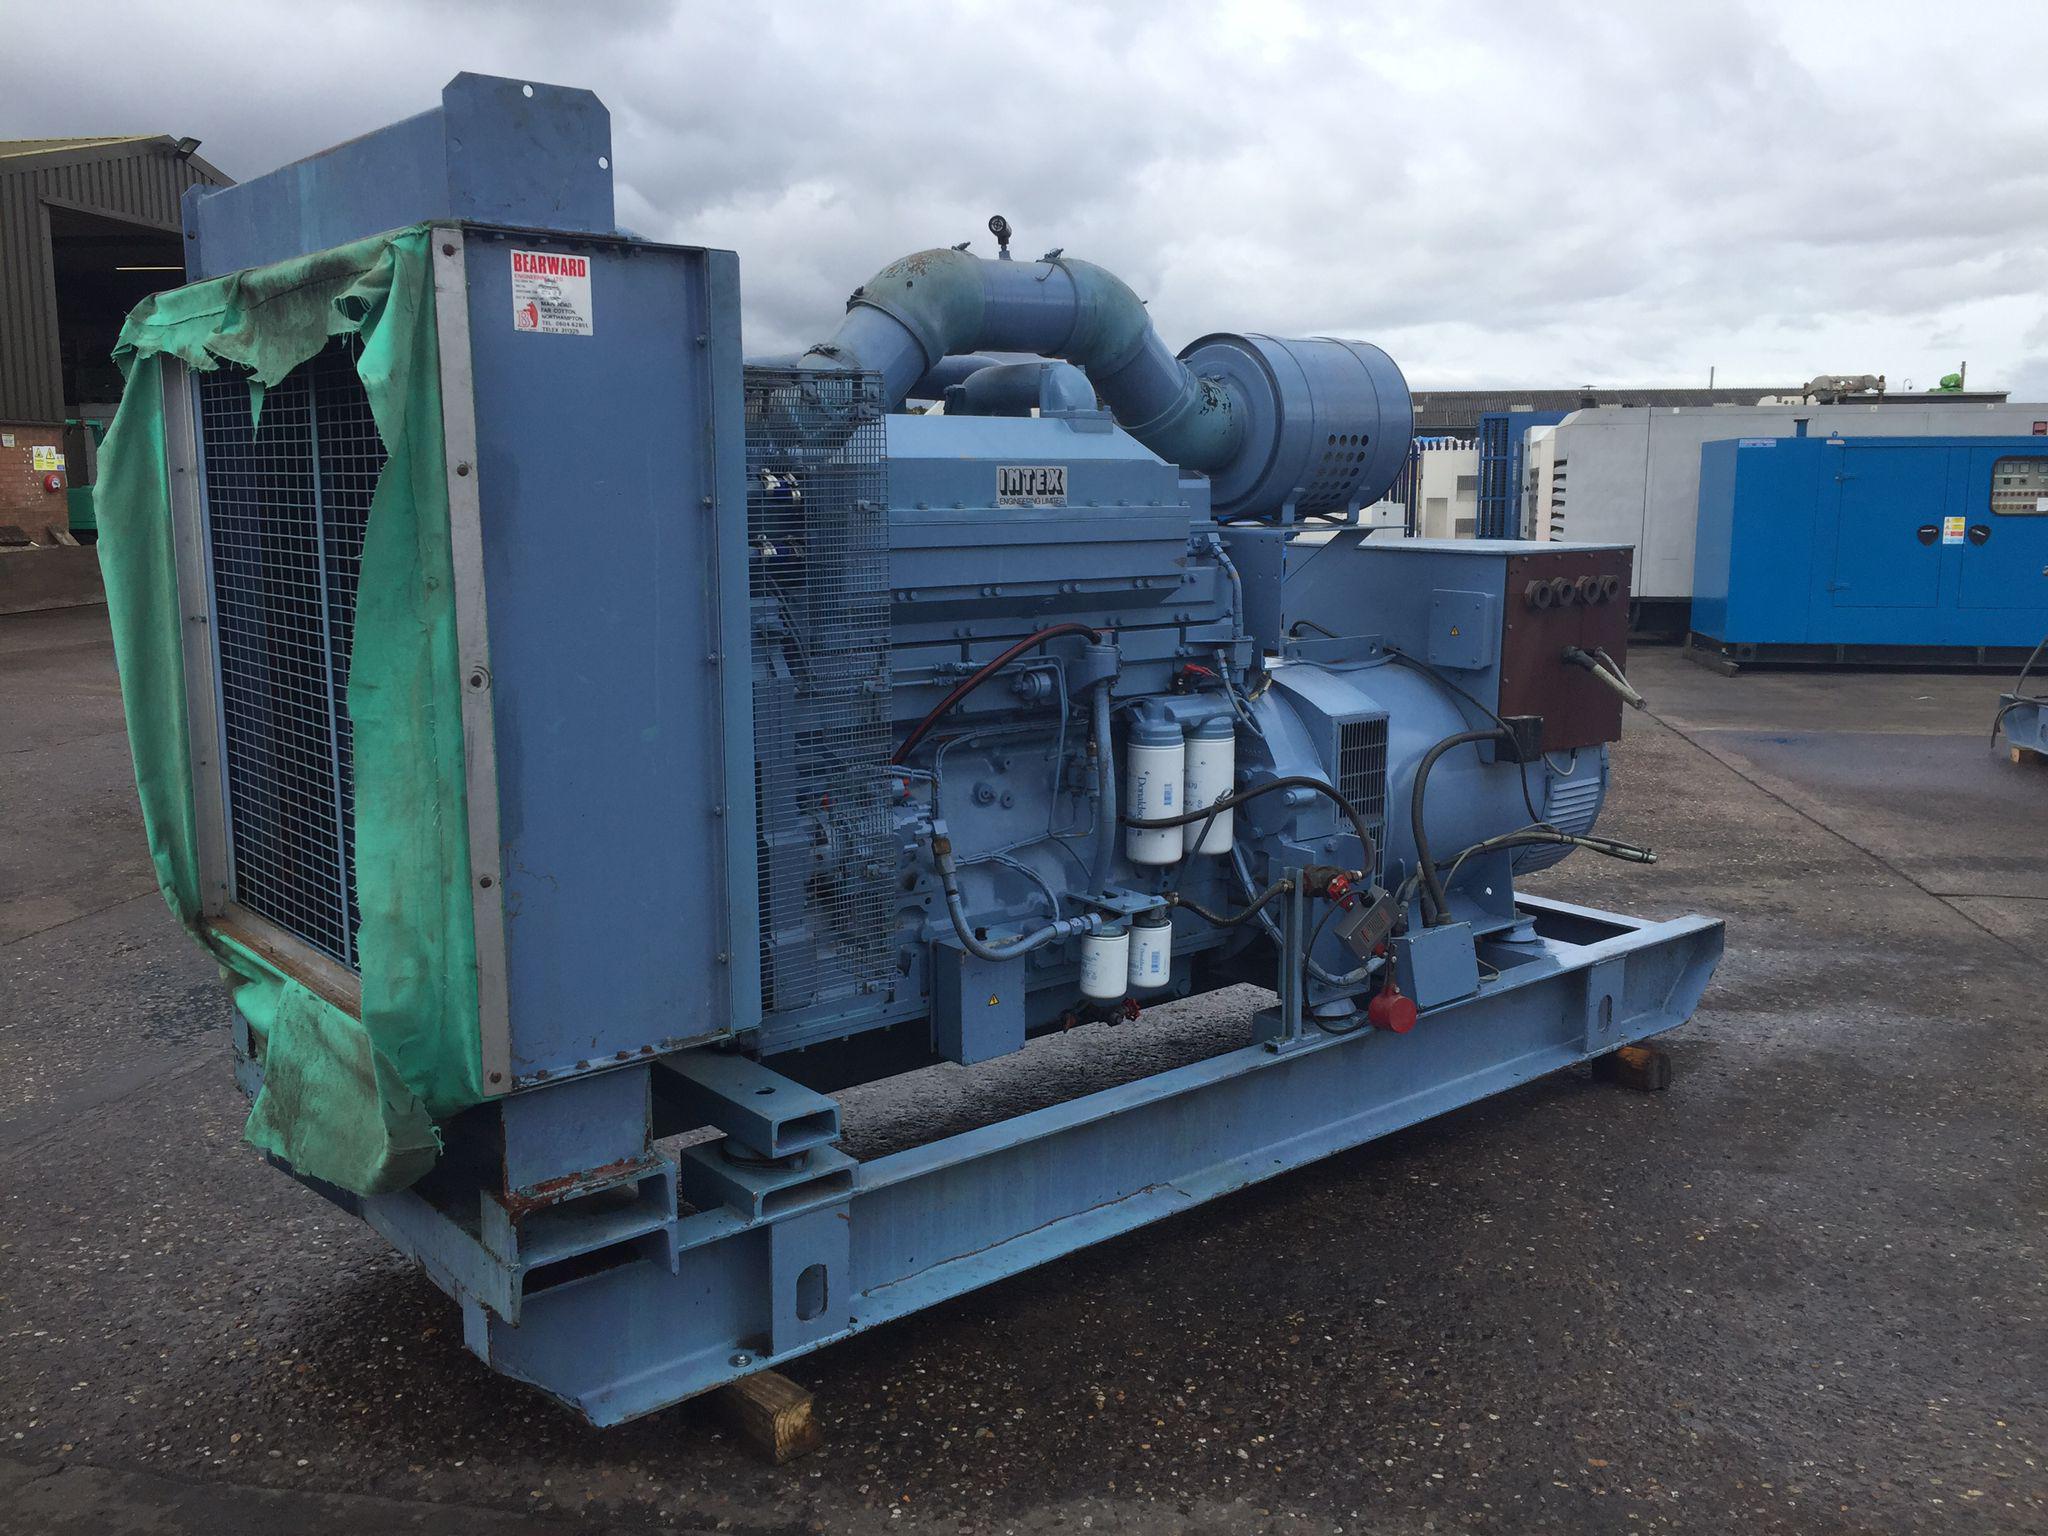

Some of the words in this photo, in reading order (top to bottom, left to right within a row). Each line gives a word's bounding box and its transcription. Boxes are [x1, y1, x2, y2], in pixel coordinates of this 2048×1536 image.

[513, 253, 586, 278] BEARWARD
[999, 468, 1064, 496] INTEX
[1136, 776, 1148, 821] Donaldso
